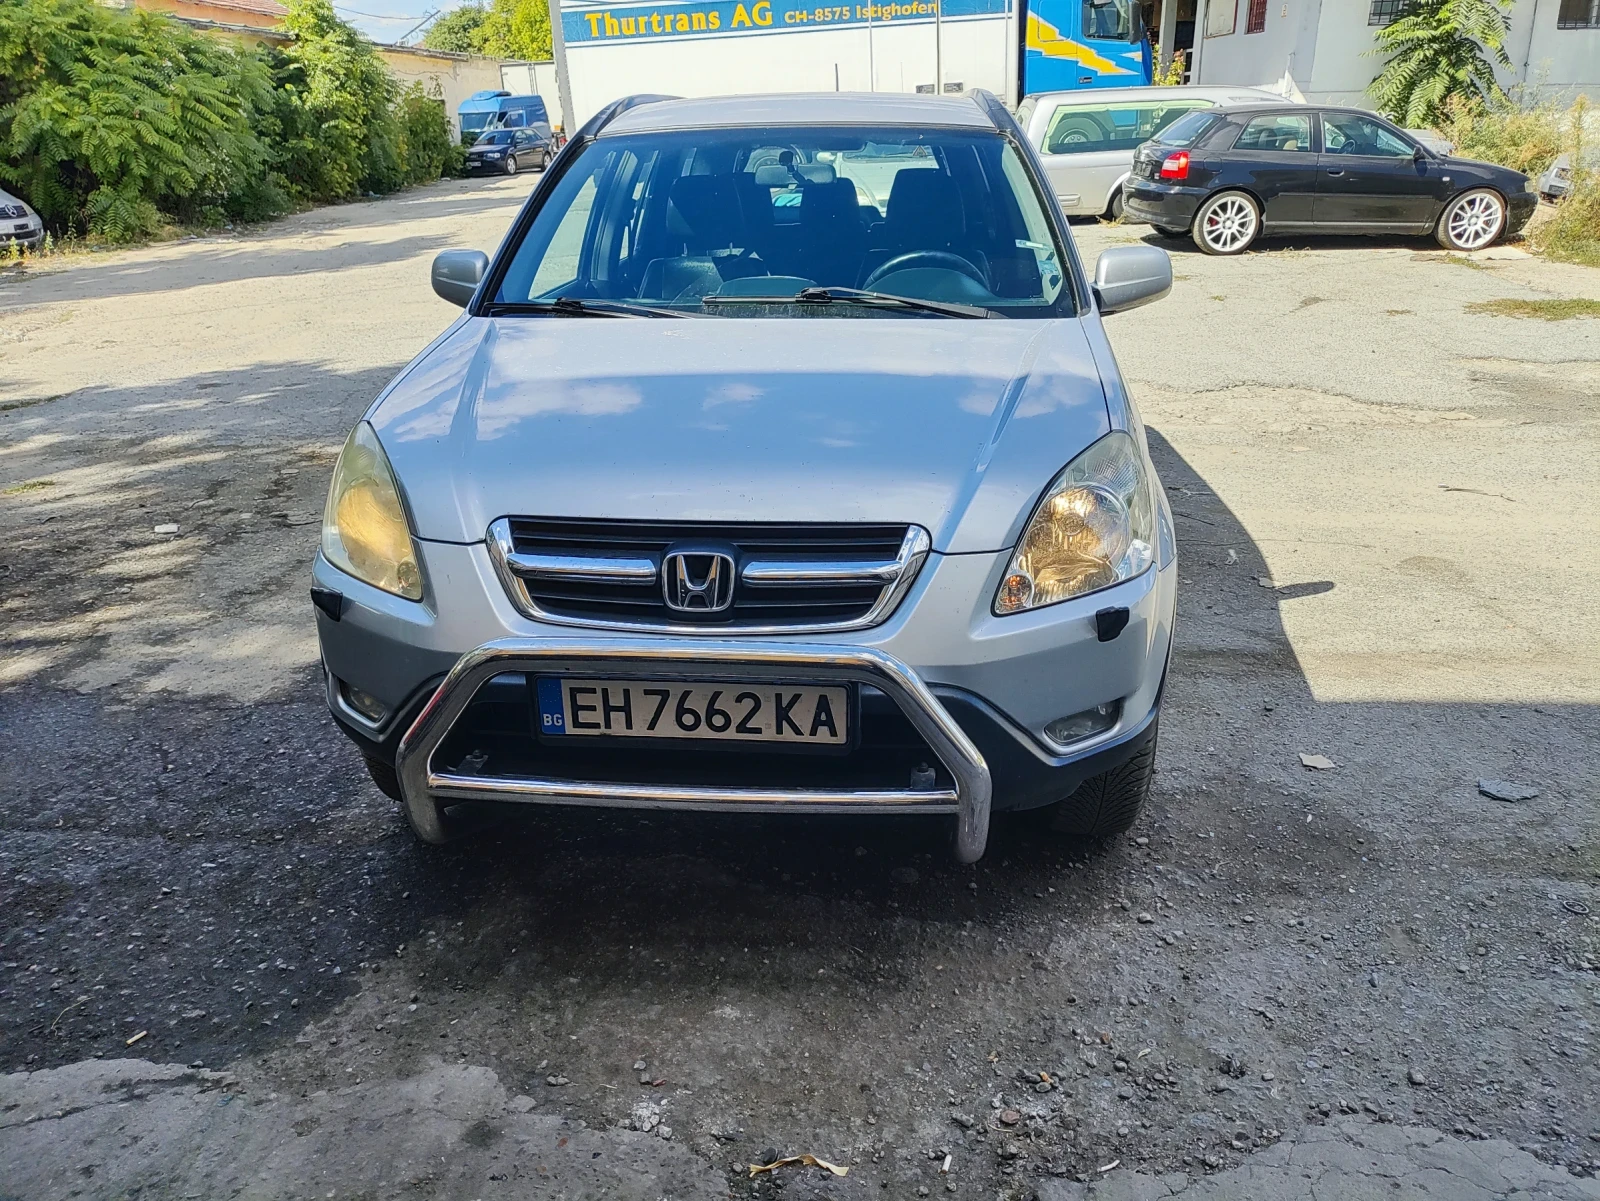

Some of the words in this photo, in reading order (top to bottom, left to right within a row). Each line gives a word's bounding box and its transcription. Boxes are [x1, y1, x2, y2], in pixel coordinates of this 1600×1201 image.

[584, 11, 720, 38] Thurtrans
[730, 1, 774, 28] AG
[784, 6, 851, 23] CH-8575
[856, 1, 938, 21] Istighofen
[542, 713, 563, 727] BG
